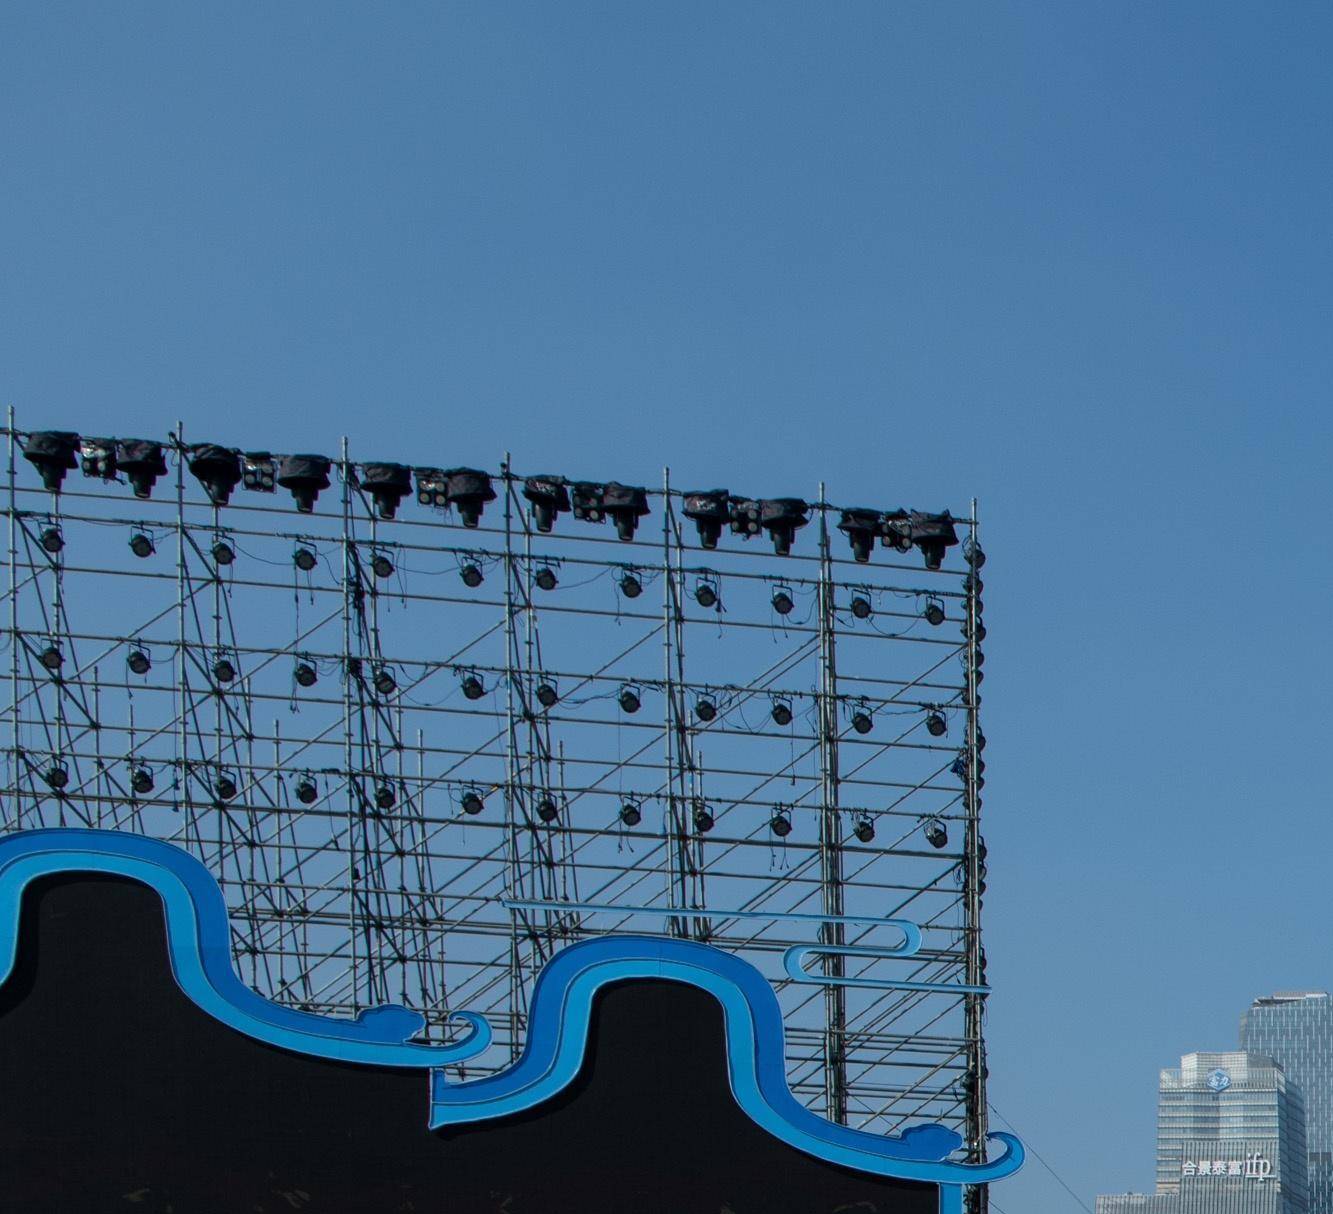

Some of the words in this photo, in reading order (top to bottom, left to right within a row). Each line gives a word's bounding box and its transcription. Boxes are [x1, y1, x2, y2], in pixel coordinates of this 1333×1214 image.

[1182, 1160, 1242, 1176] 合景泰富
[1245, 1152, 1272, 1181] ifp
